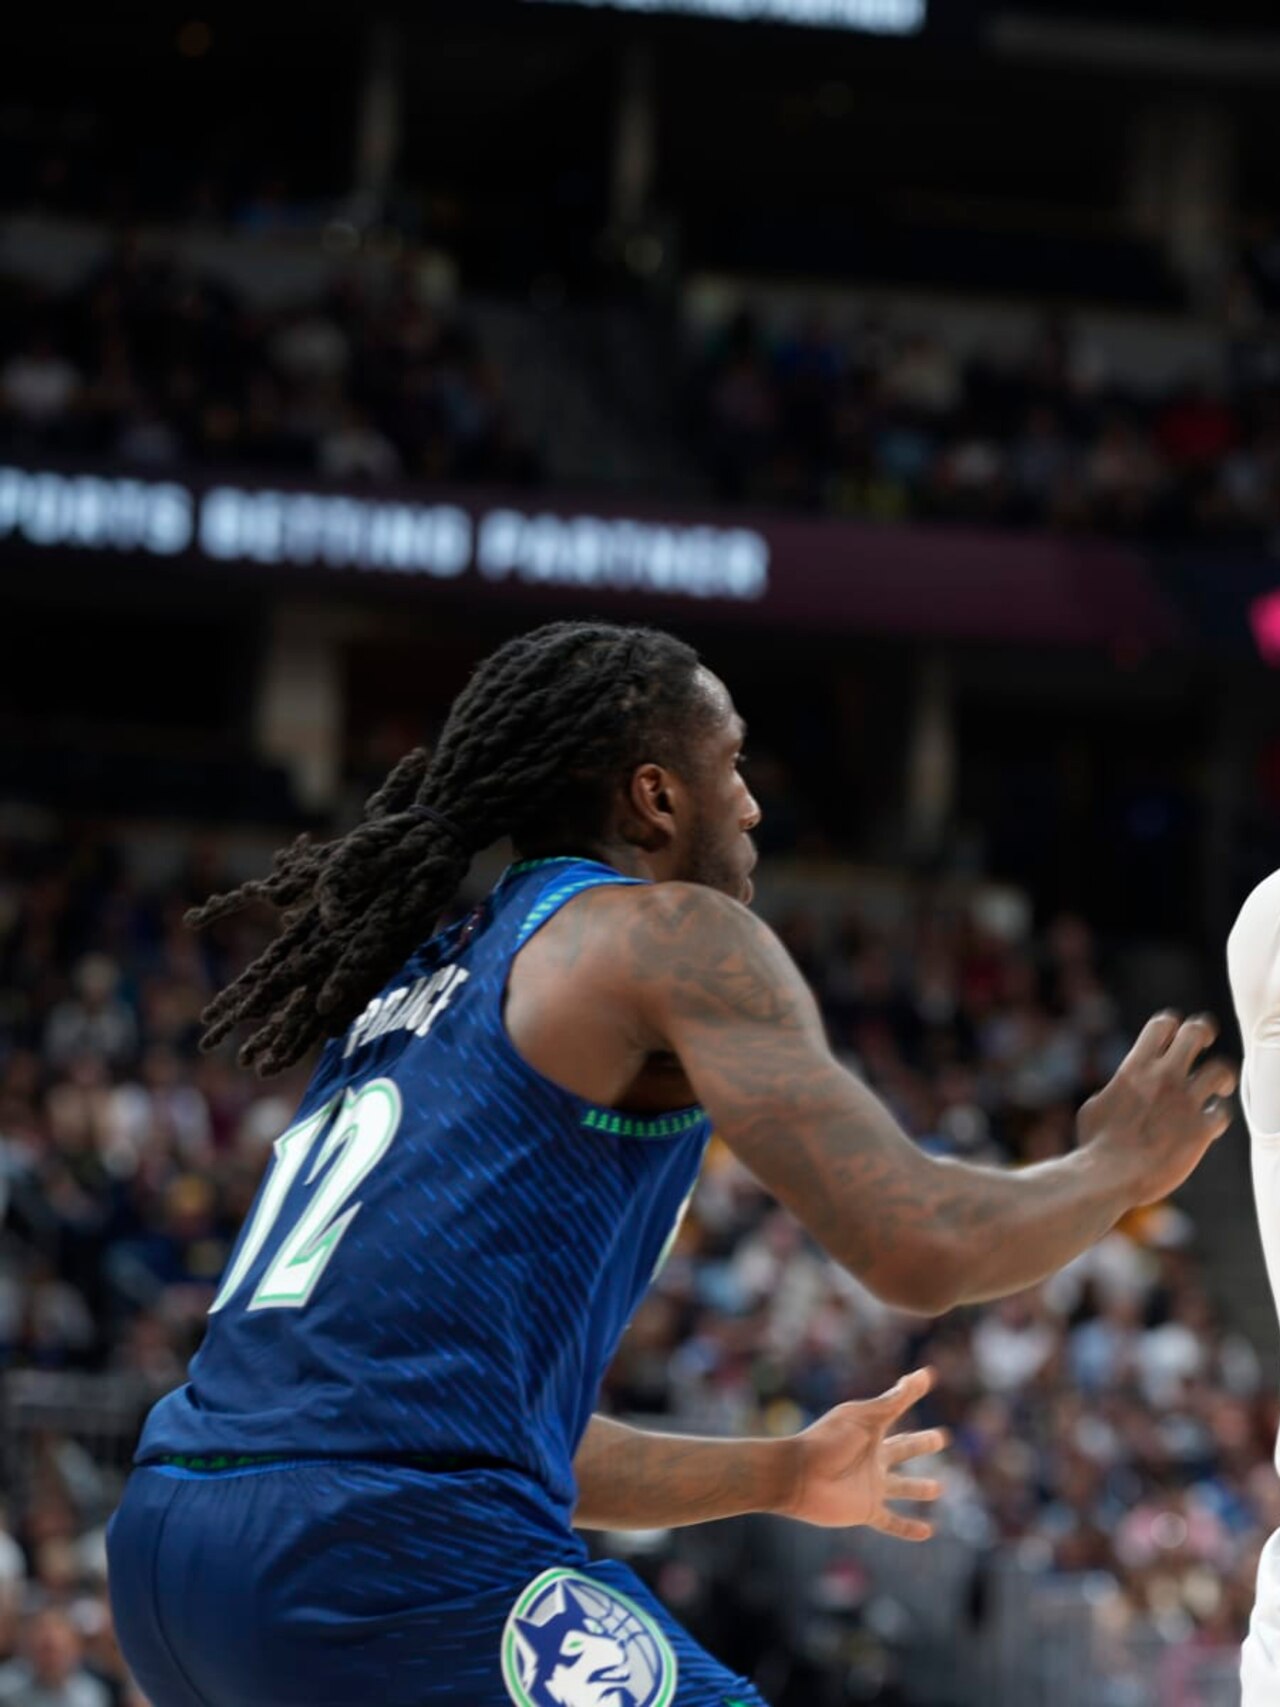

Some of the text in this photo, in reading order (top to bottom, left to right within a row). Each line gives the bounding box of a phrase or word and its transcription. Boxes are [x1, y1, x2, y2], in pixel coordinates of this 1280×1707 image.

[198, 487, 471, 577] BETTING
[475, 508, 769, 600] PARTNER
[207, 1077, 402, 1314] 12
